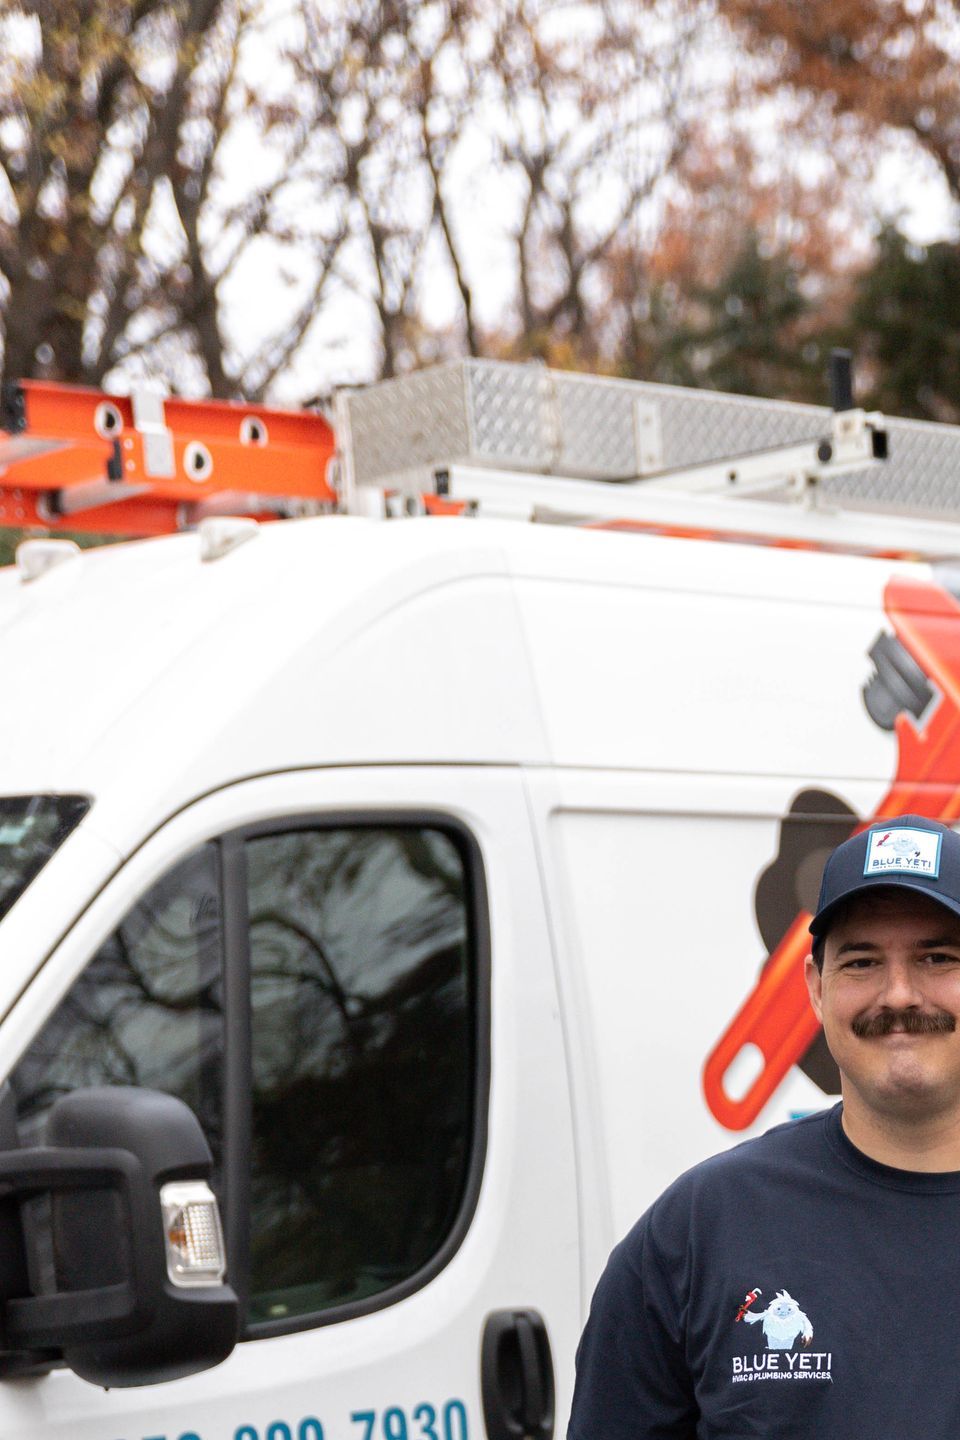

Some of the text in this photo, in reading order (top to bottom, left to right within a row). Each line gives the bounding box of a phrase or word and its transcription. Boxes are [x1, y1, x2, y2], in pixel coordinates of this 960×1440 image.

[872, 857, 902, 866] BLUE
[905, 857, 931, 868] YETI
[732, 1352, 832, 1373] BLUE YETI
[732, 1375, 748, 1383] HVAC
[754, 1371, 792, 1381] PLUMBING
[793, 1371, 831, 1380] SERVICES
